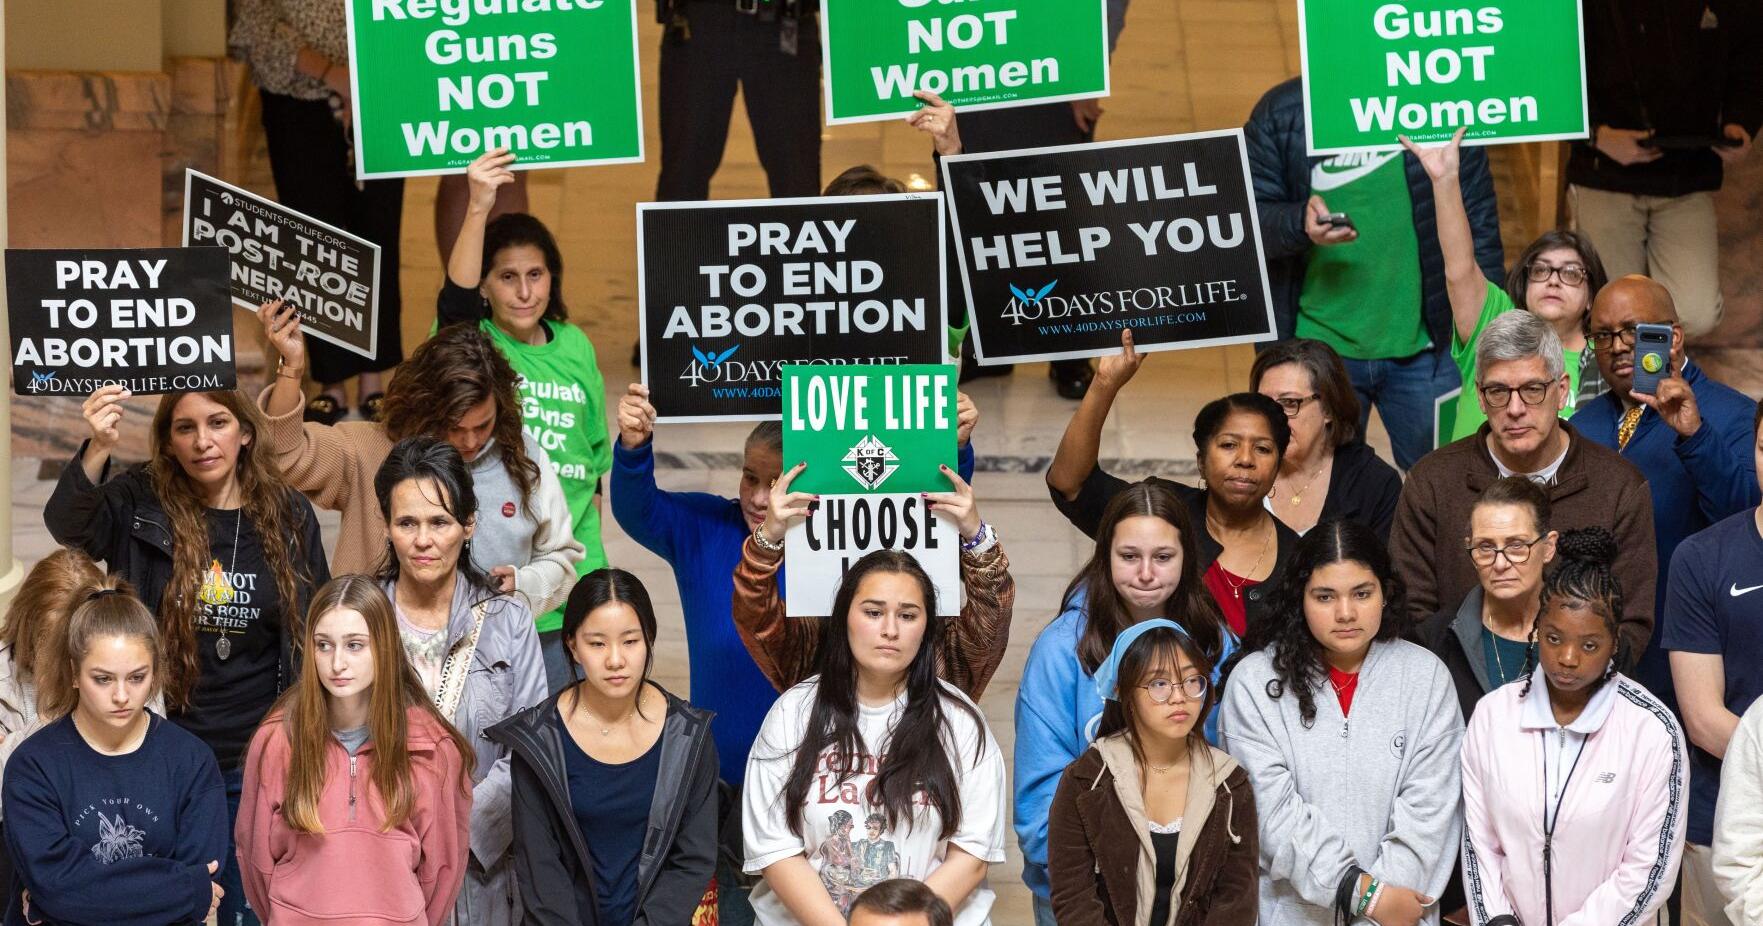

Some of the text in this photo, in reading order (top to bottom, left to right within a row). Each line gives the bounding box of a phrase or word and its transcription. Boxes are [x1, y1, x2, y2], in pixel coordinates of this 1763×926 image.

[907, 9, 1017, 54] NOT
[1373, 3, 1504, 40] Guns
[425, 29, 558, 65] Guns
[1385, 45, 1495, 87] NOT
[437, 71, 549, 112] NOT
[870, 55, 1059, 100] Women
[1349, 95, 1538, 132] Women
[401, 119, 593, 157] Women
[979, 162, 1217, 215] WE WILL
[203, 197, 359, 277] I AM THE
[234, 198, 347, 250] STUDENTSFORLIFE.ORG
[728, 219, 856, 257] PRAY
[971, 212, 1245, 271] HELP YOU
[55, 259, 168, 290] PRAY
[193, 217, 370, 307] POST-ROE
[699, 260, 884, 298] TO END
[41, 298, 196, 329] TO END
[231, 261, 363, 332] NERATION
[662, 298, 926, 339] ABORTION
[1038, 311, 1207, 336] WWW.40DAYSFORLIFE.COM
[14, 334, 231, 368] ABORTION
[790, 374, 949, 431] LOVE LIFE
[857, 448, 864, 456] K
[877, 448, 885, 456] C
[805, 496, 938, 552] CHOOSE
[220, 571, 257, 591] NOT
[213, 616, 248, 628] THIS
[217, 605, 261, 619] BORN
[74, 804, 96, 826] PICK
[102, 797, 130, 805] YOUR
